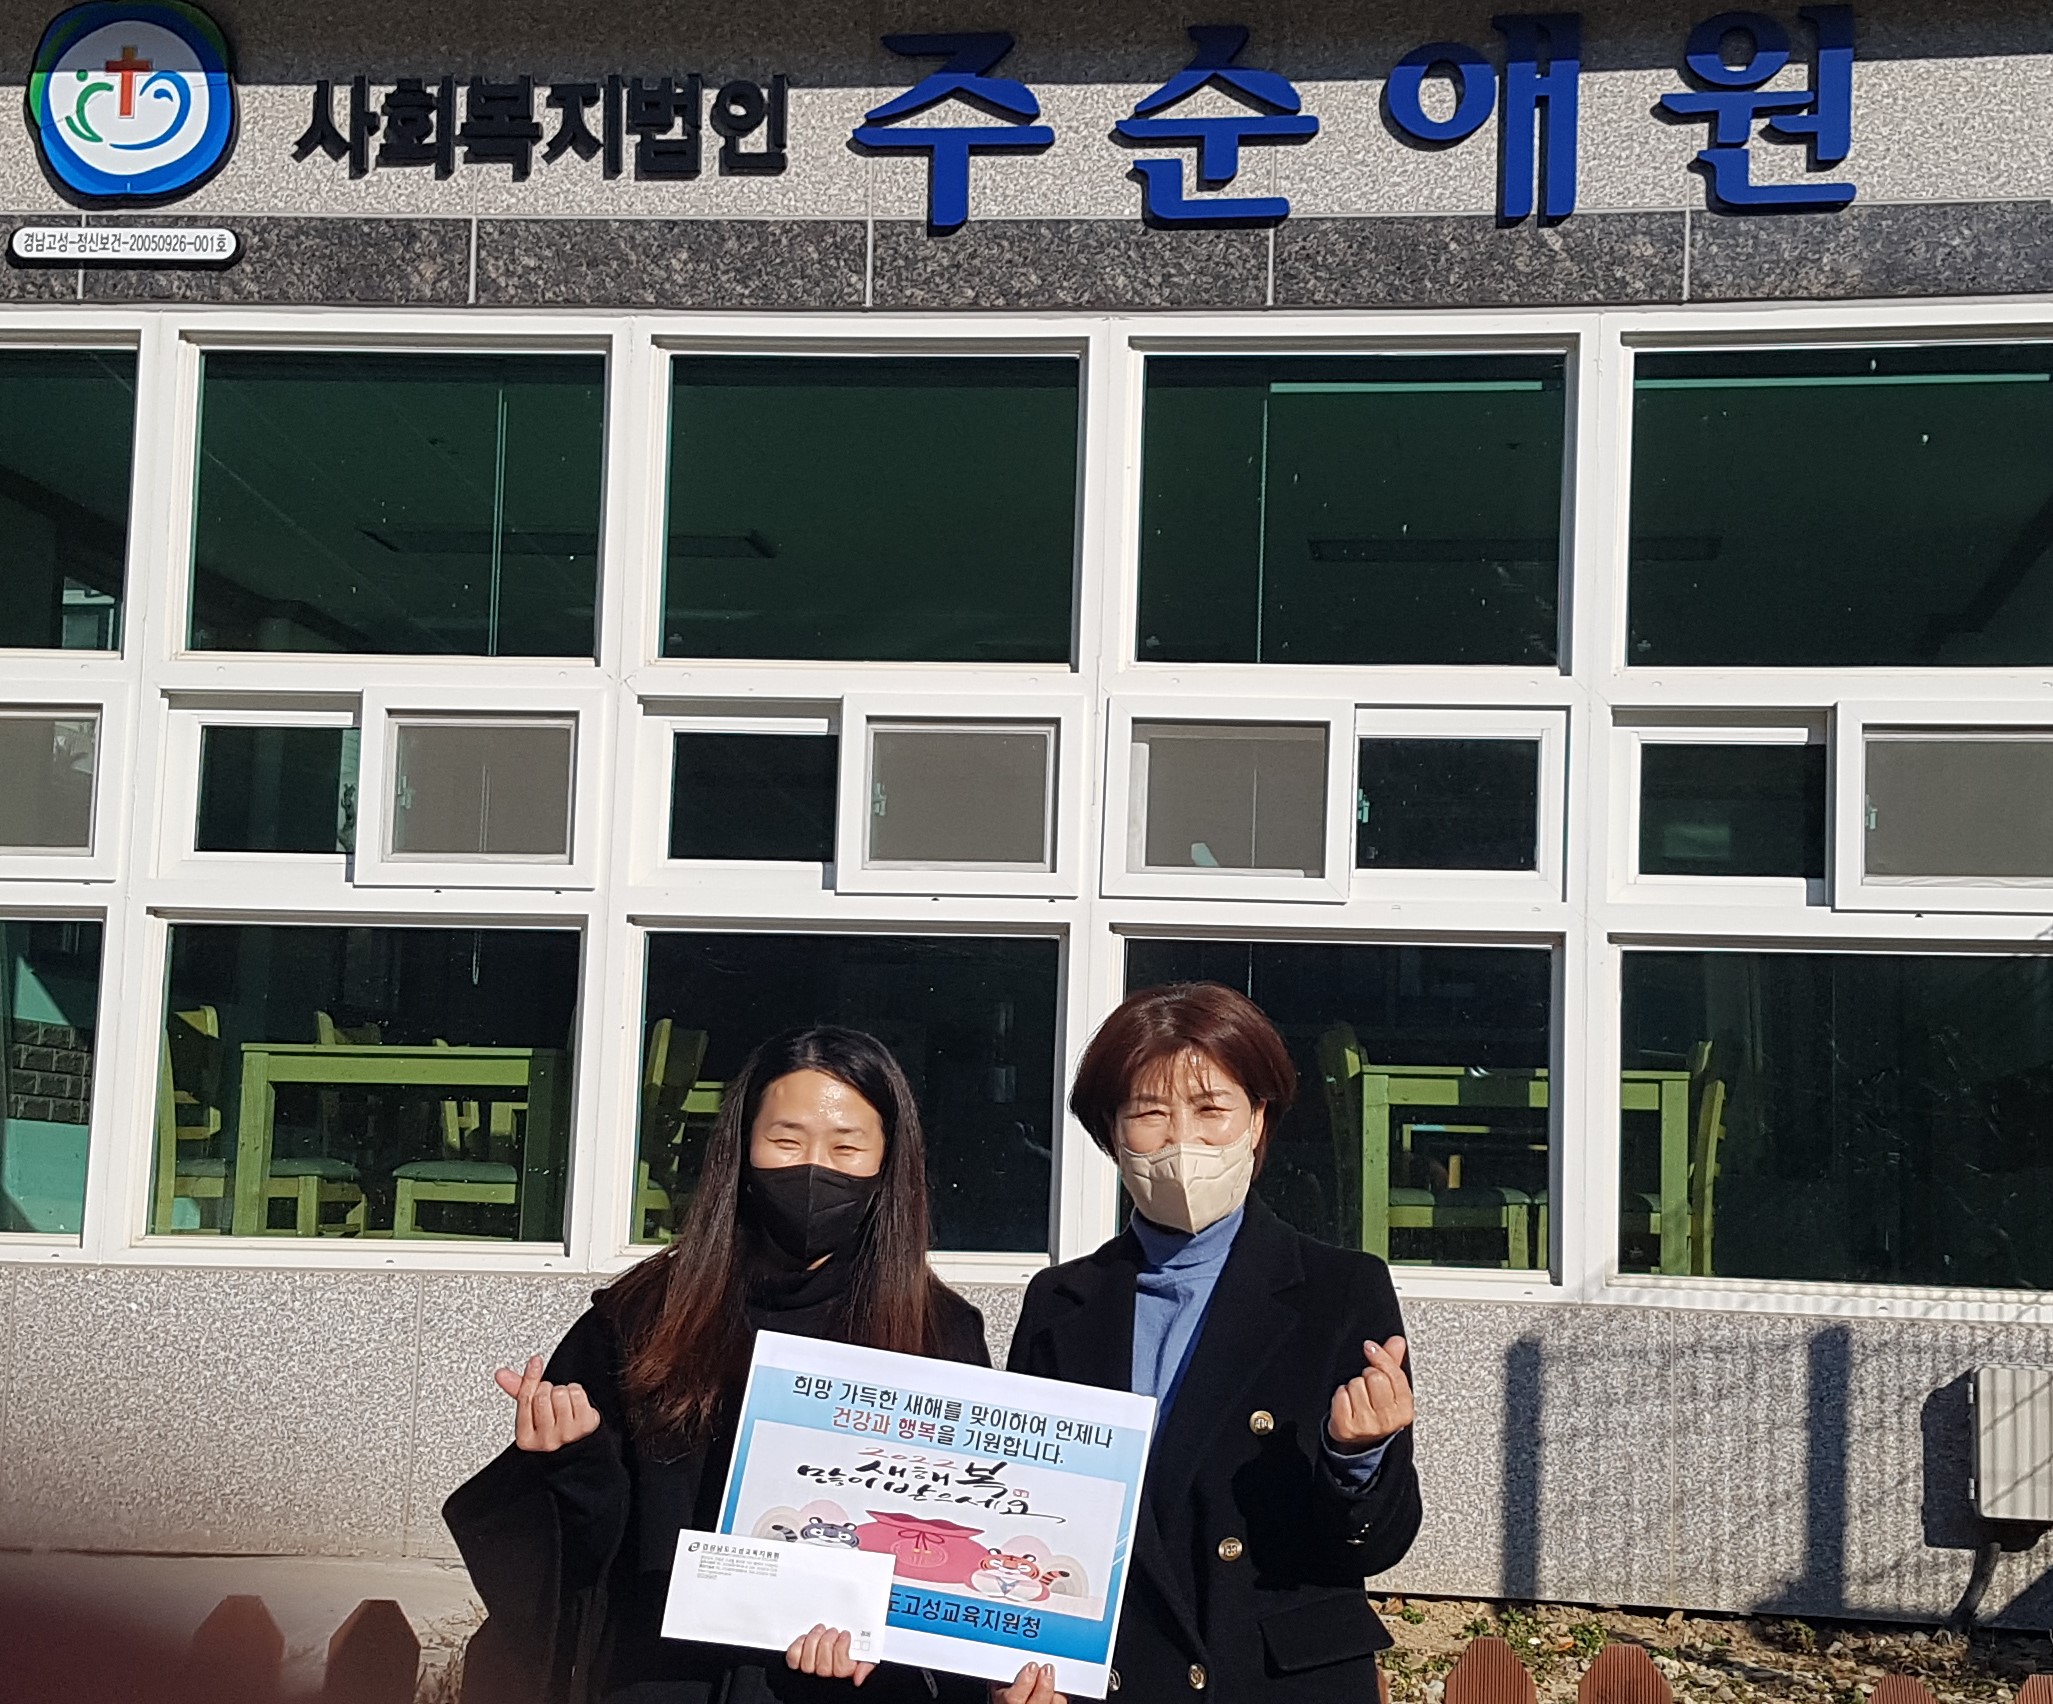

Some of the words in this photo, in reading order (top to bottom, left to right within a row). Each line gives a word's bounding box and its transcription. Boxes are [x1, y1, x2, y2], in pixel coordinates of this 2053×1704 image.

[292, 74, 789, 182] 사회복지법인
[848, 4, 1857, 236] 주순애원
[23, 232, 228, 253] 경남고성-정신보건-20050926-001호
[792, 1375, 834, 1400] 희망
[838, 1382, 899, 1411] 가득한
[903, 1393, 962, 1422] 새해를
[969, 1404, 1048, 1437] 맞이하여
[1055, 1419, 1114, 1449] 언제나
[832, 1406, 892, 1435] 건강과
[898, 1417, 956, 1446] 행복을
[962, 1428, 1064, 1465] 기원합니다.
[796, 1463, 879, 1489] 많이
[857, 1446, 959, 1470] 2022
[855, 1459, 950, 1487] 새해
[955, 1460, 1009, 1499] 복
